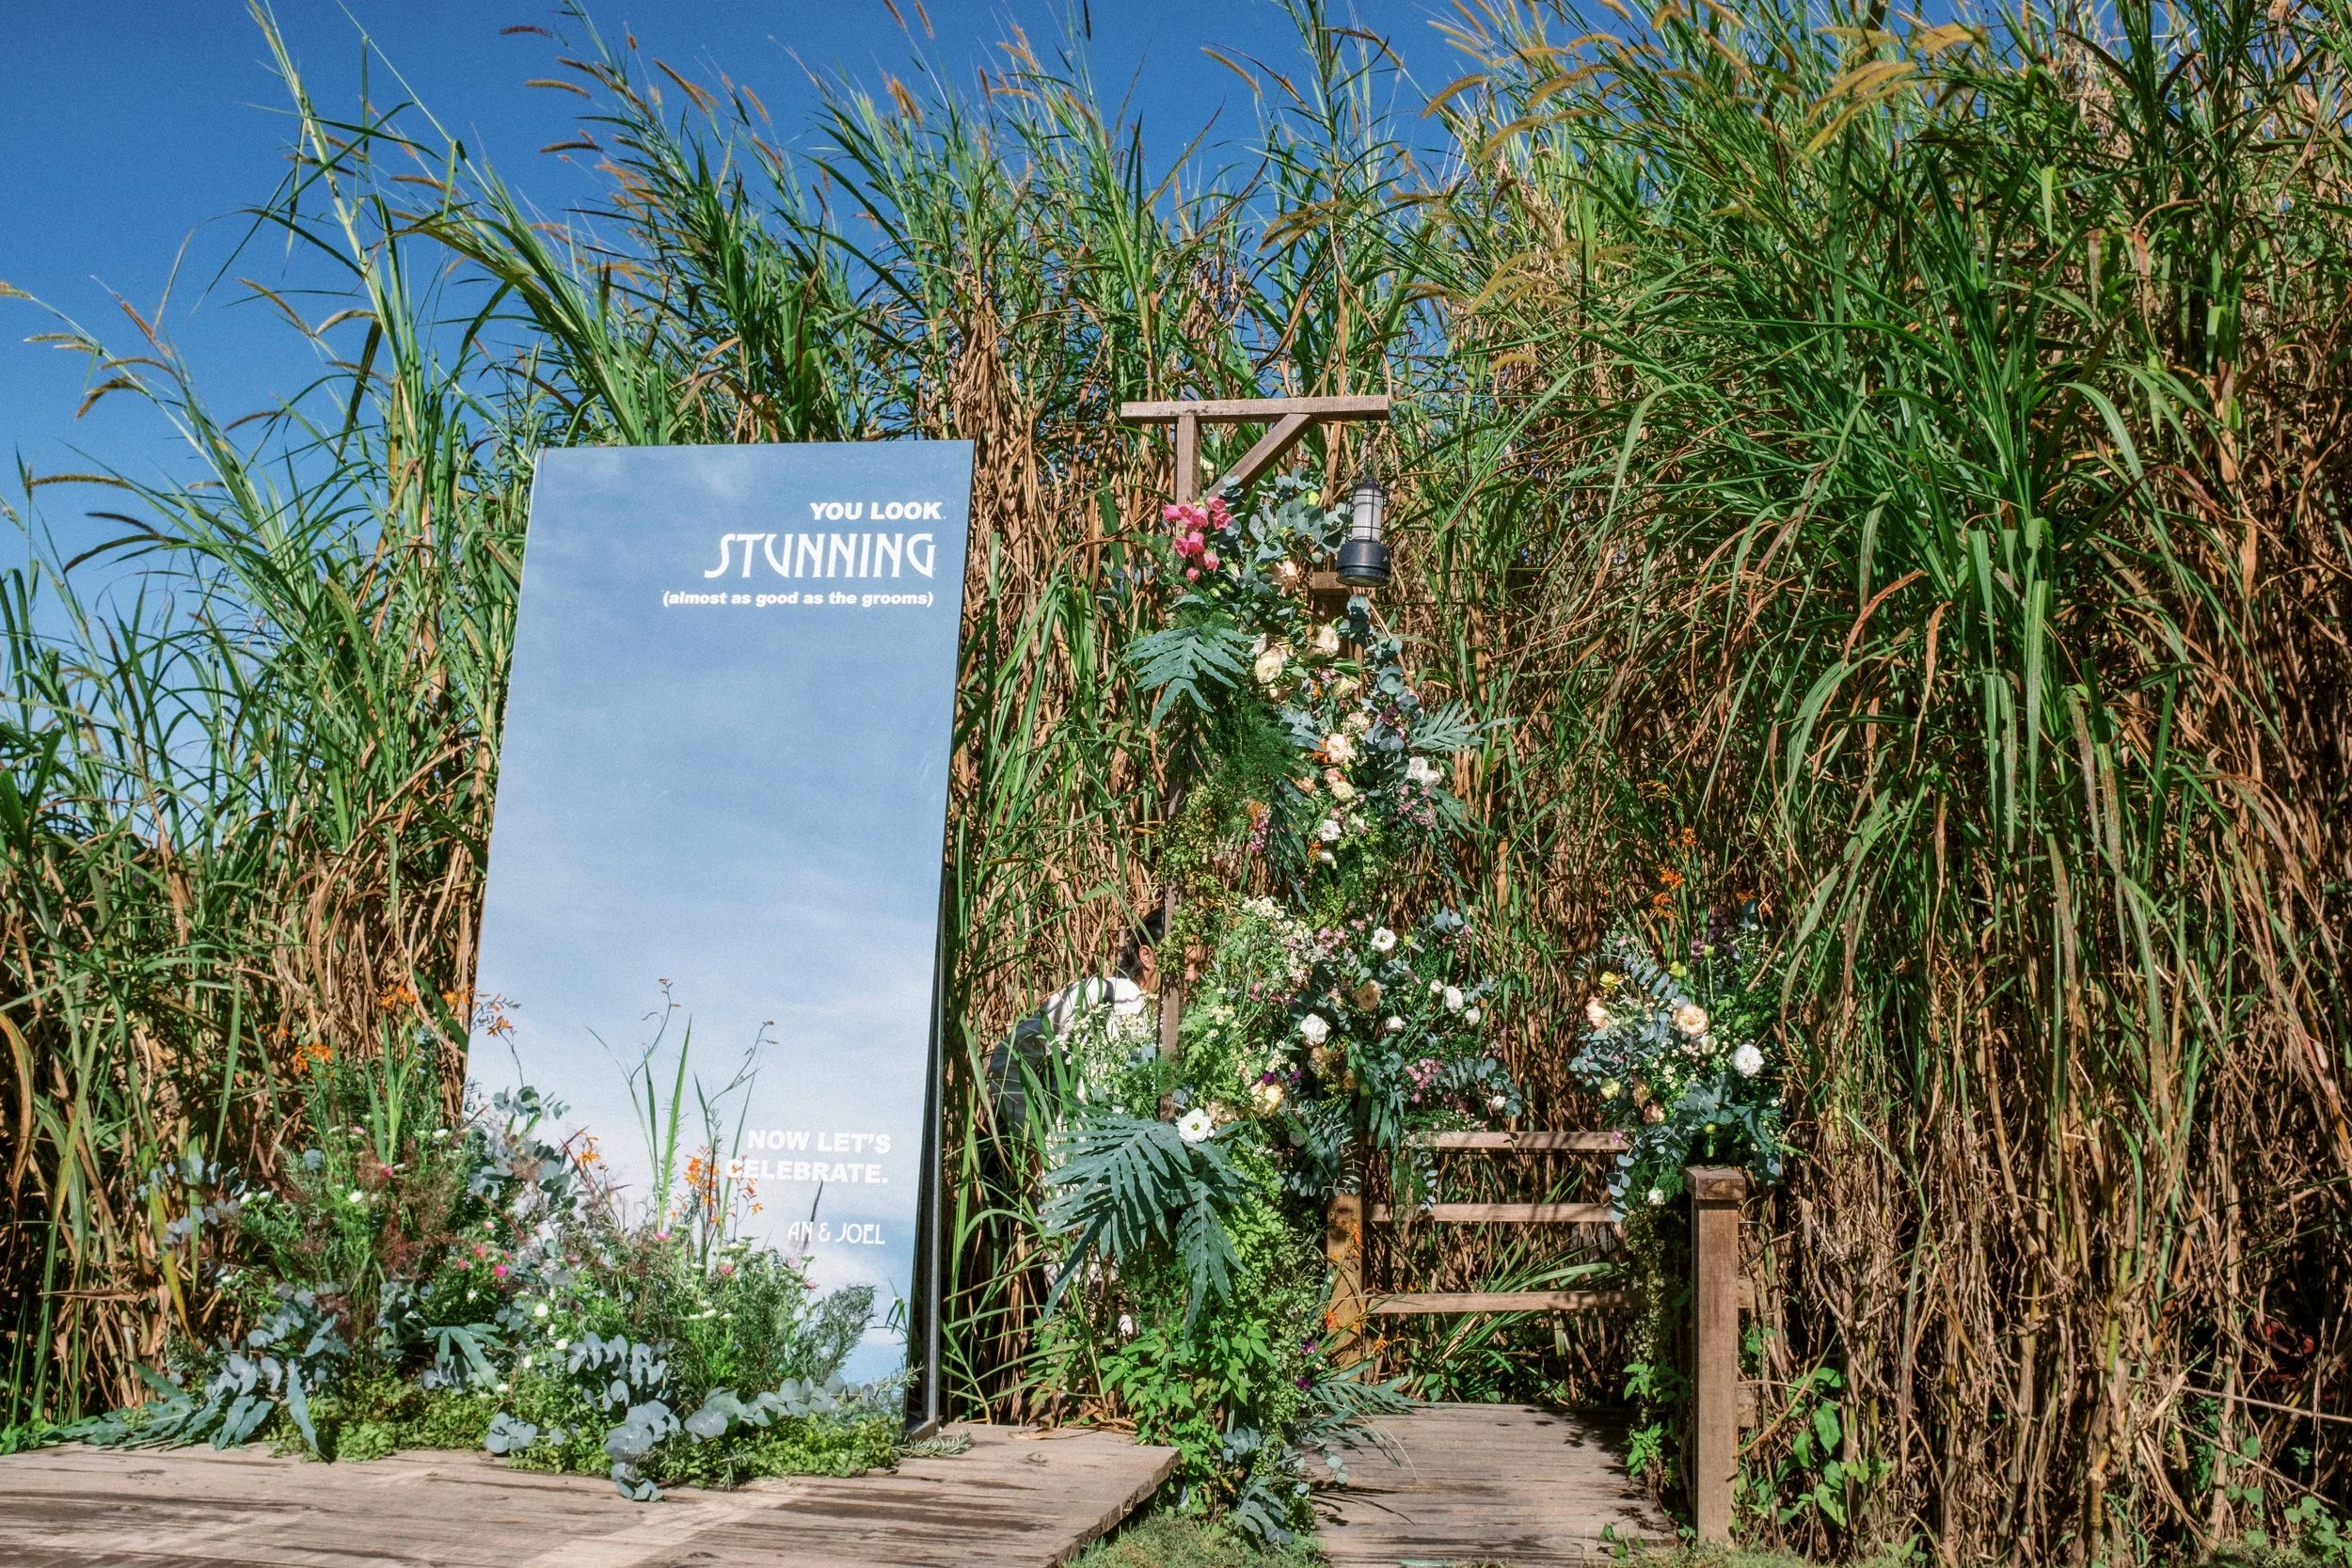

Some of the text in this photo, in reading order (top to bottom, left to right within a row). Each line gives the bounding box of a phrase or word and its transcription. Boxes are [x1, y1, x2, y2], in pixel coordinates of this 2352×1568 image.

[810, 502, 942, 520] YOU LOOK
[704, 533, 936, 578] STUNNING
[662, 591, 934, 608] (almost as good as the grooms)
[748, 1130, 892, 1154] NOW LET'S
[725, 1159, 889, 1183] CELEBRATE.
[787, 1221, 886, 1245] AN & JOEL
